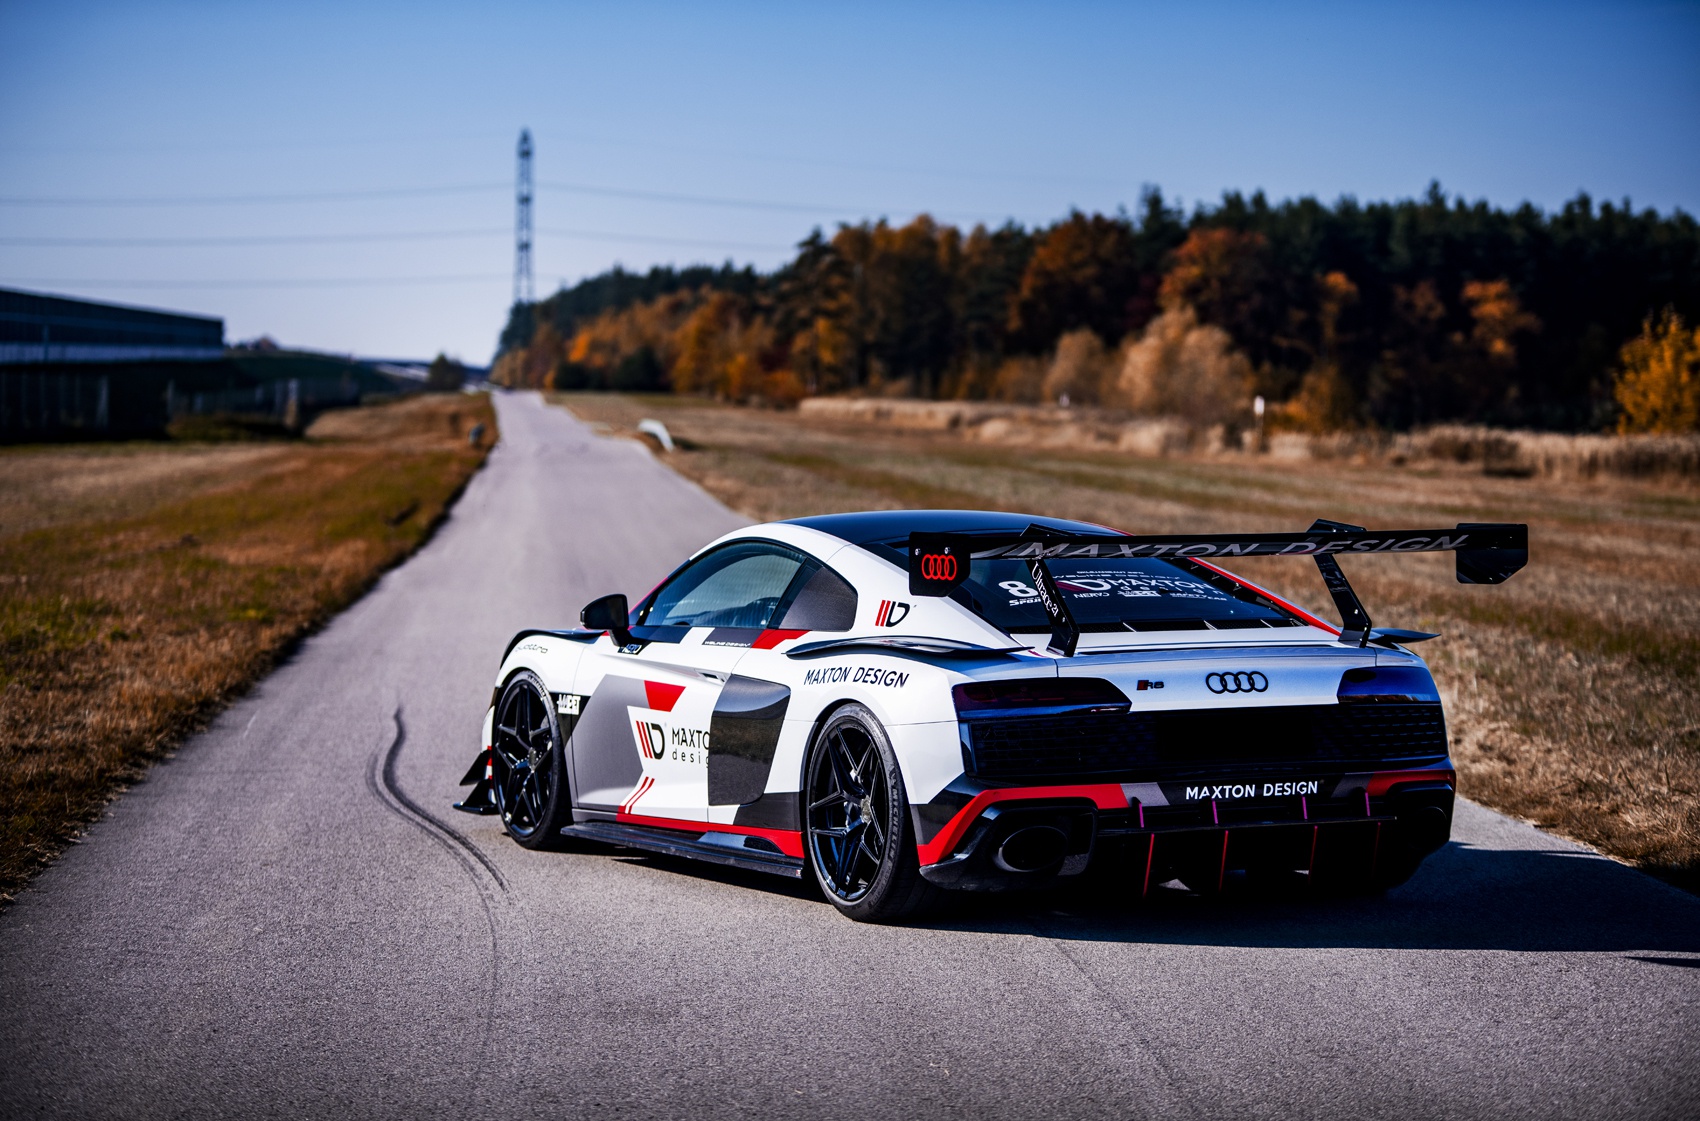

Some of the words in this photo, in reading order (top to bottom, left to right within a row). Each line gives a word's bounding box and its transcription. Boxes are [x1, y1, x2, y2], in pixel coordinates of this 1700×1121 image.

[1017, 541, 1259, 557] MAXTON
[1273, 535, 1469, 554] DESIGN
[998, 580, 1039, 597] 8
[1106, 579, 1216, 590] MAXTON
[803, 666, 852, 685] MAXTON
[852, 666, 910, 688] DESIGN
[1185, 784, 1256, 800] MAXTON
[1263, 781, 1318, 797] DESIGN
